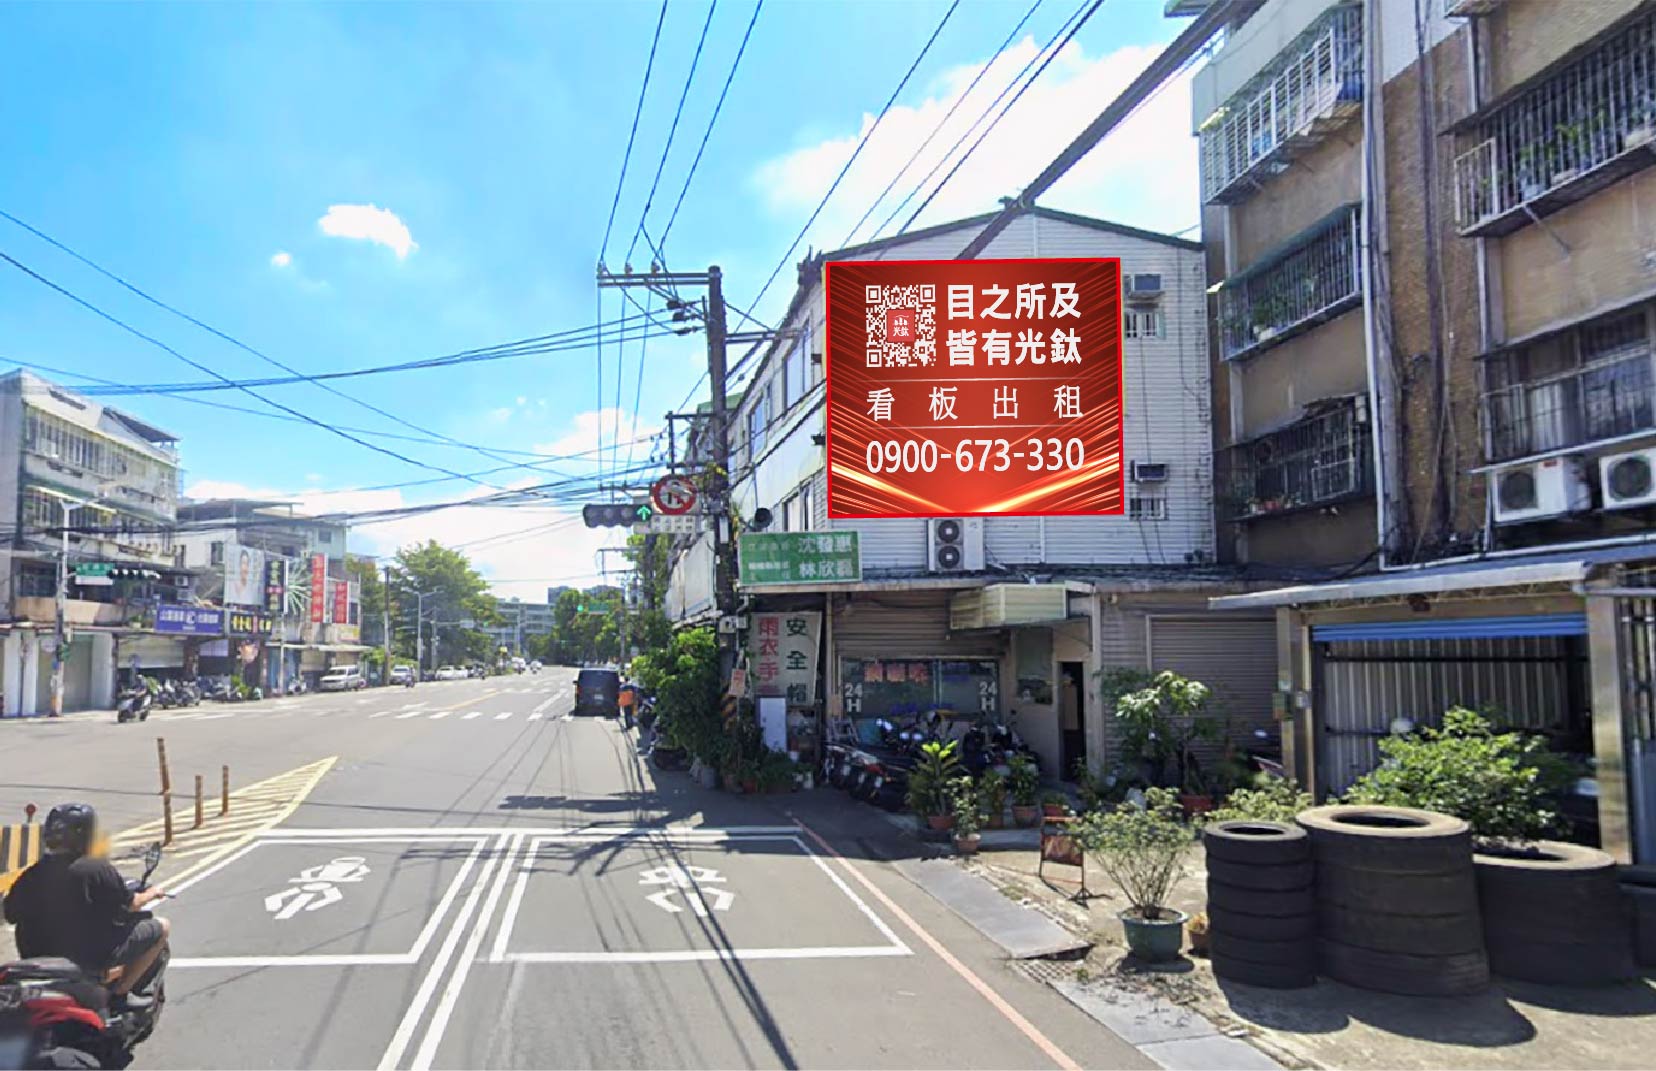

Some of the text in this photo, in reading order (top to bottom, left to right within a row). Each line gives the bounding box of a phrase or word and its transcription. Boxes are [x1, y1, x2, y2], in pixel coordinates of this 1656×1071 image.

[947, 282, 1082, 320] 目之所及
[946, 327, 1083, 366] 皆有光鈦
[866, 384, 1084, 422] 看板出租
[865, 437, 1085, 473] 0900-673-330
